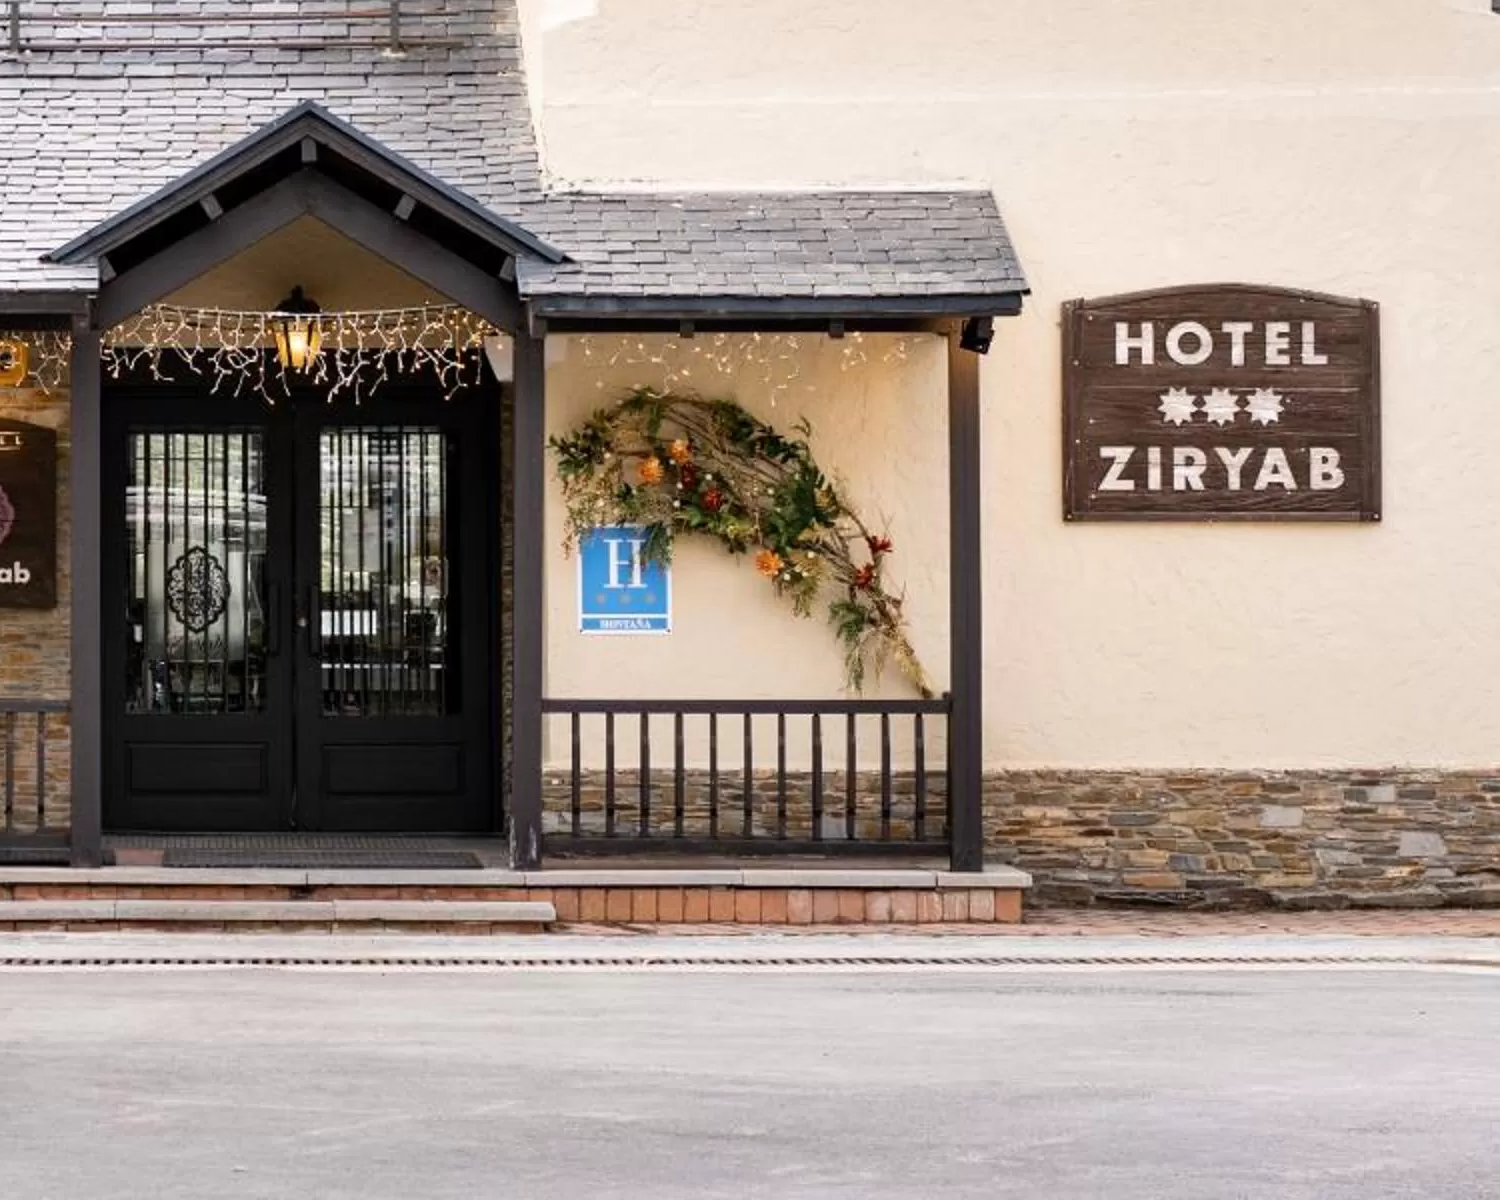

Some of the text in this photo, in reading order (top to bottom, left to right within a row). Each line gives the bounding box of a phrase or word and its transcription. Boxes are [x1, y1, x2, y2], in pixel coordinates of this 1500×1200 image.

[1113, 320, 1329, 366] HOTEL
[1097, 446, 1346, 492] ZIRYAB
[603, 537, 649, 589] H
